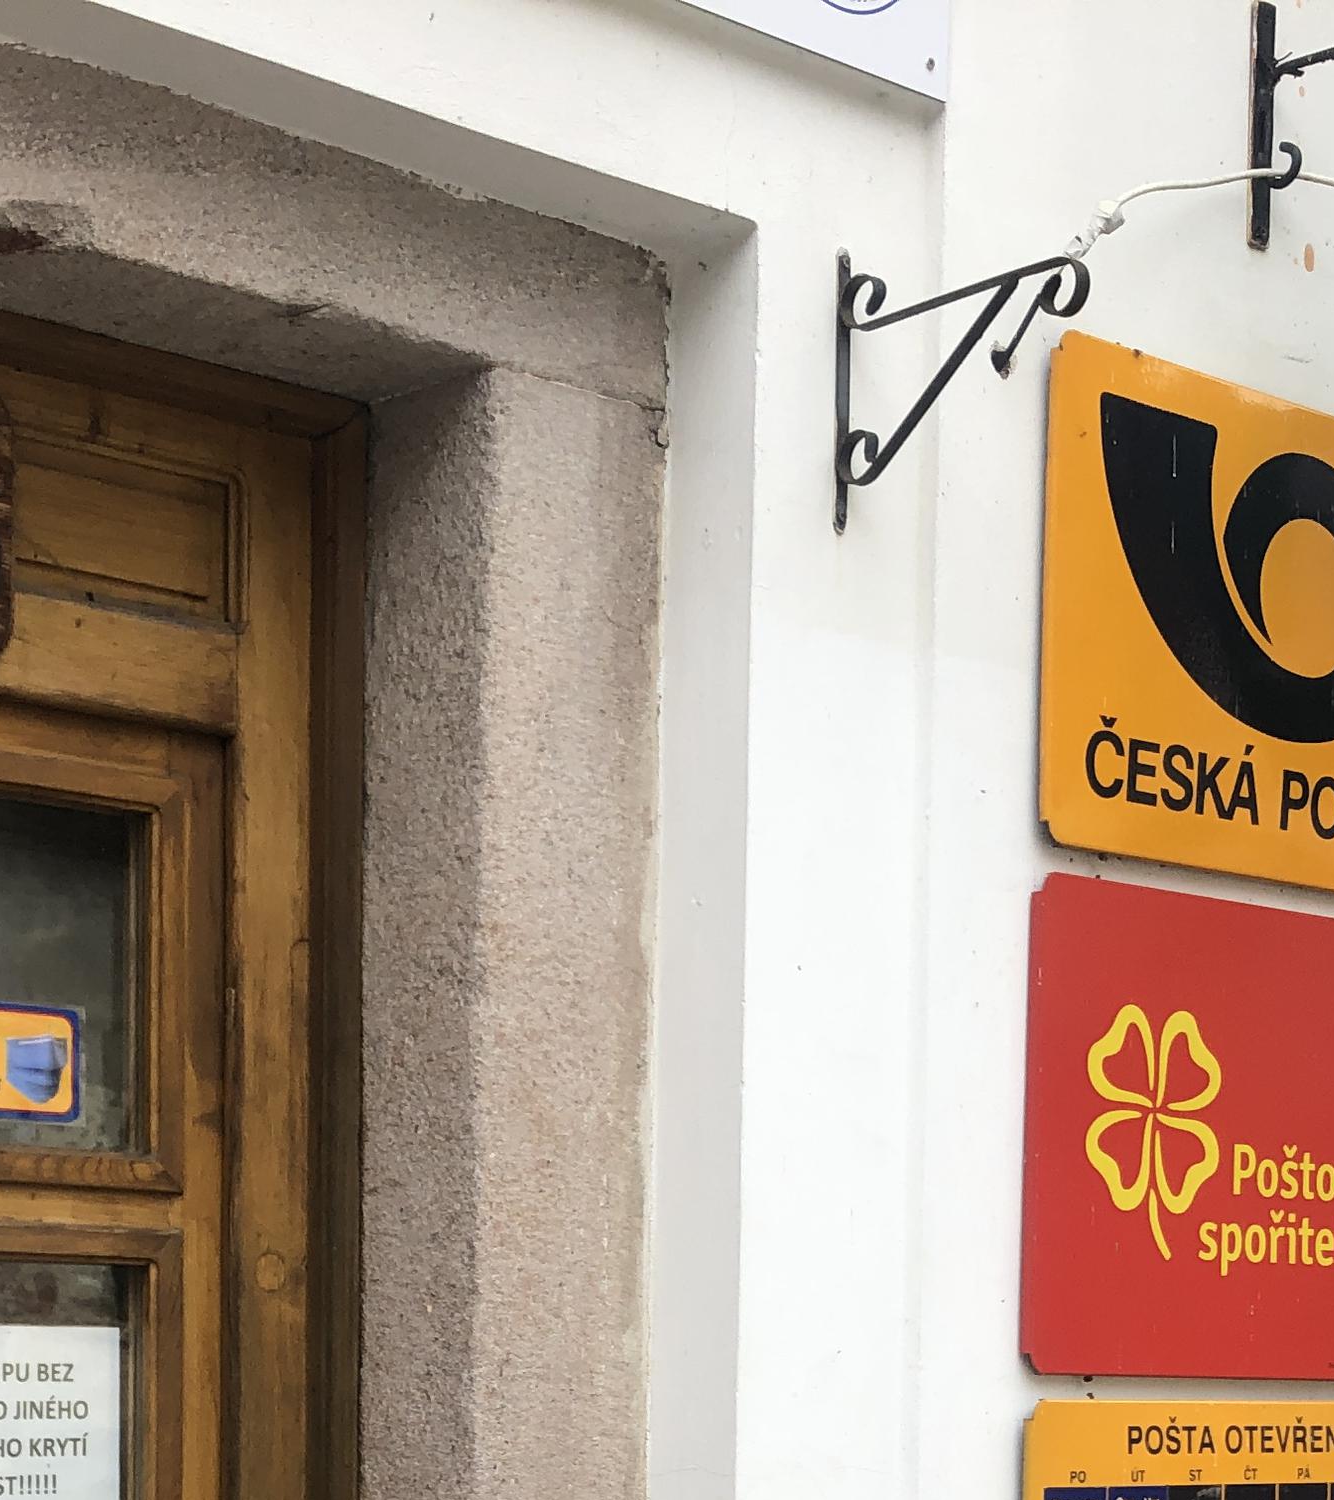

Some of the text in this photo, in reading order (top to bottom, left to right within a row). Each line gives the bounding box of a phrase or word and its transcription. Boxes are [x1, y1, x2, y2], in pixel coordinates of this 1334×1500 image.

[1084, 715, 1259, 825] ČESKÁ
[37, 1362, 74, 1383] BEZ
[13, 1395, 89, 1420] JINÉHO
[29, 1432, 89, 1457] KRYTÍ
[1127, 1416, 1215, 1455] POŠTA
[1070, 1471, 1086, 1483] PO
[1189, 1470, 1202, 1482] ST
[1244, 1464, 1258, 1480] ČT
[1298, 1464, 1310, 1479] PÁ
